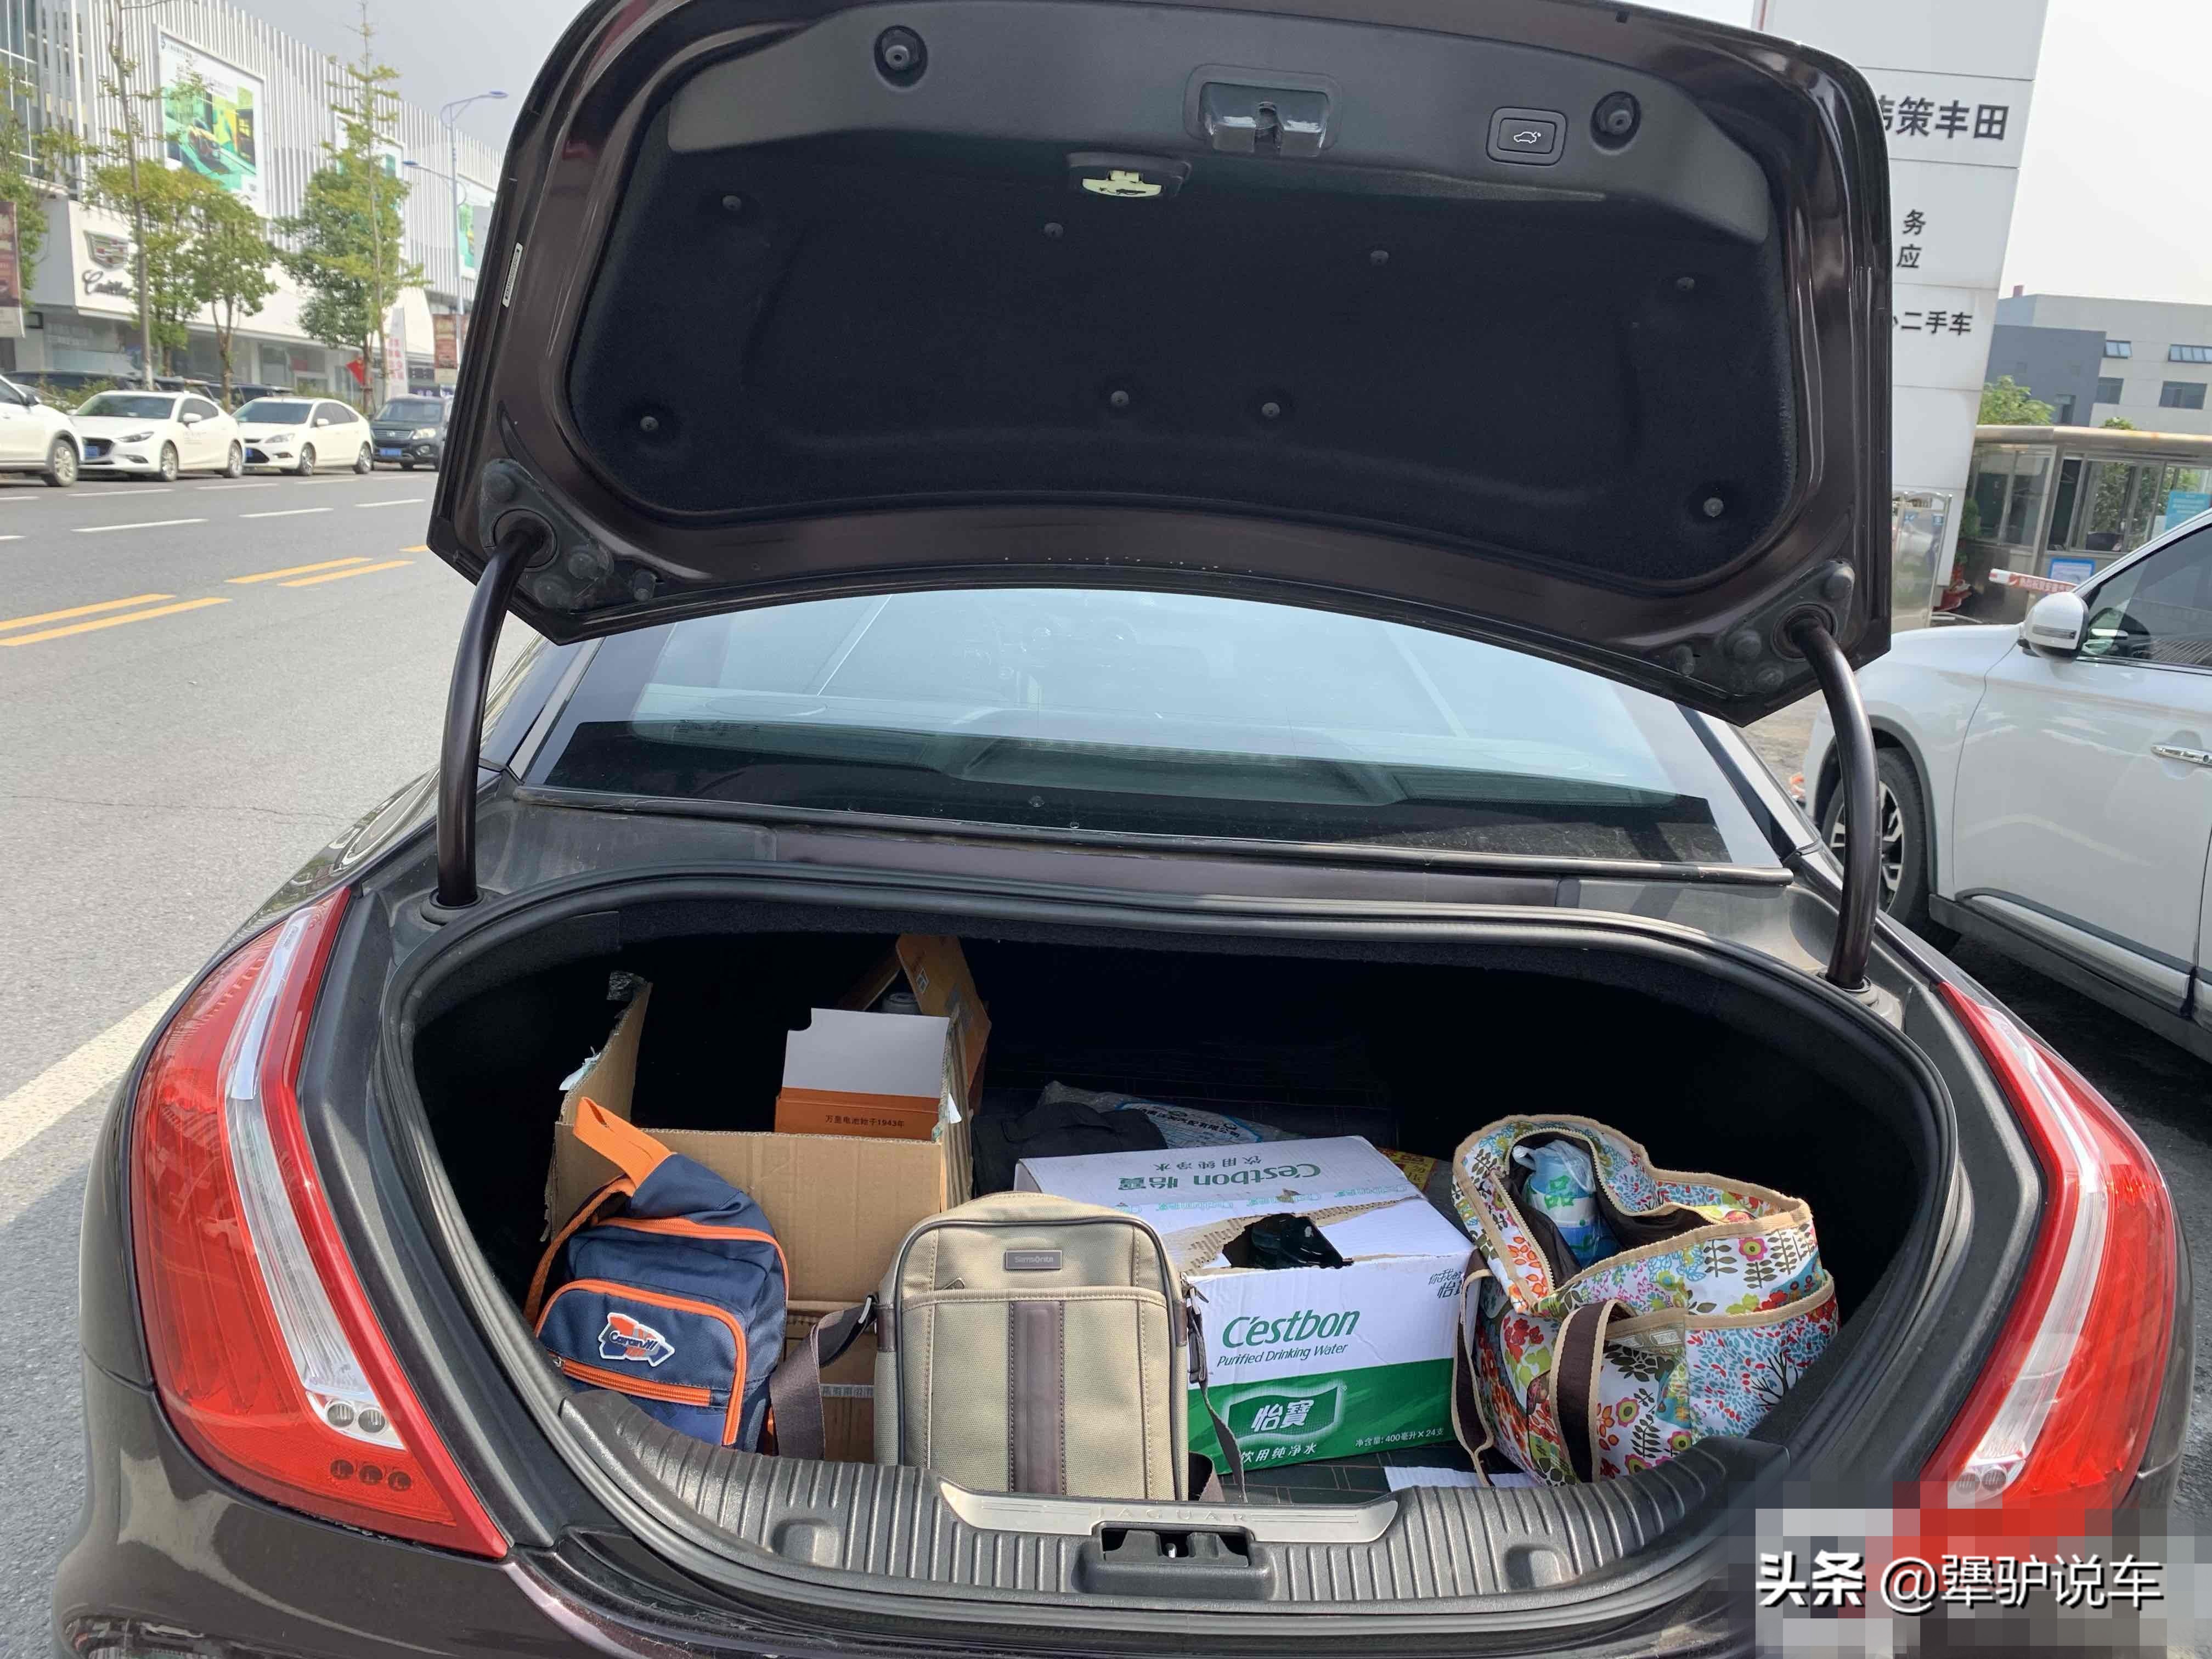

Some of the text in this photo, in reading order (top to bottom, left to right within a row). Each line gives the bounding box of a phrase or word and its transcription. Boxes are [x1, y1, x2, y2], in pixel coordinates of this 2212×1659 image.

[1902, 209, 1926, 235] 务
[1896, 244, 1922, 268] 应
[1893, 311, 1973, 336] 二手车
[1153, 1155, 1261, 1172] 饮用纯净水
[1217, 1343, 1348, 1367] Purified Drinking Water
[1240, 1442, 1317, 1464] 饮用纯净水
[1097, 1506, 1247, 1522] JAGUAR
